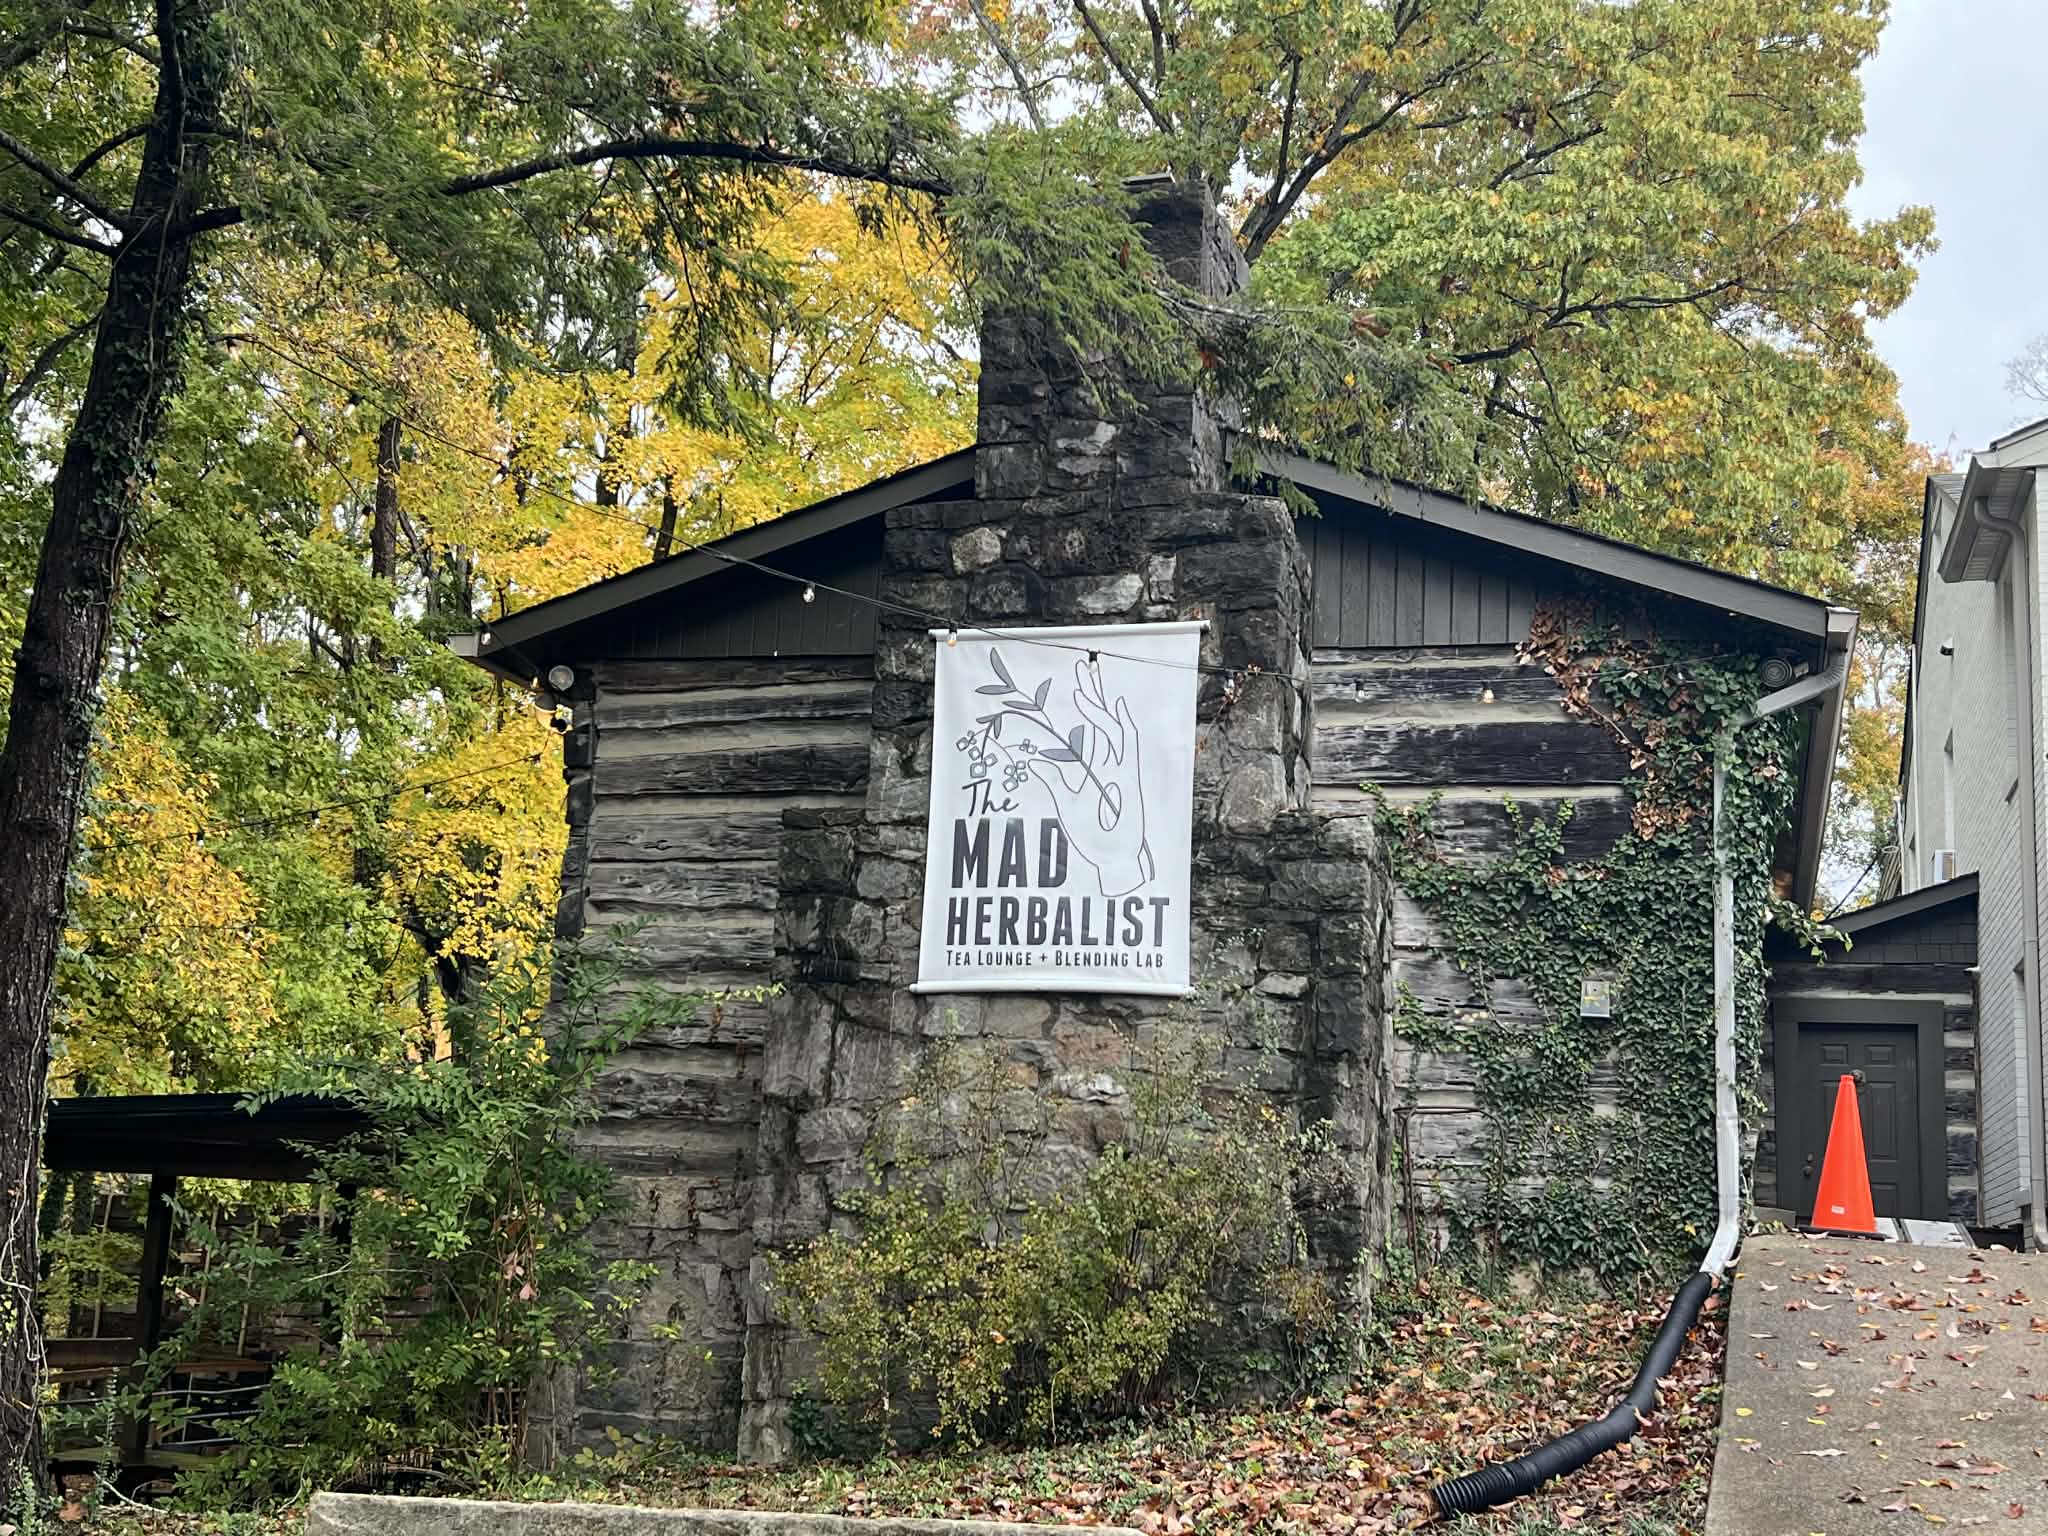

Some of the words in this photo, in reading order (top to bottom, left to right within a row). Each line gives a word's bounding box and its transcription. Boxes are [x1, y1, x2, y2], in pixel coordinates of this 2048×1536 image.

[961, 778, 1020, 817] The
[951, 817, 1069, 889] MAD
[946, 895, 1170, 947] HERBALIST
